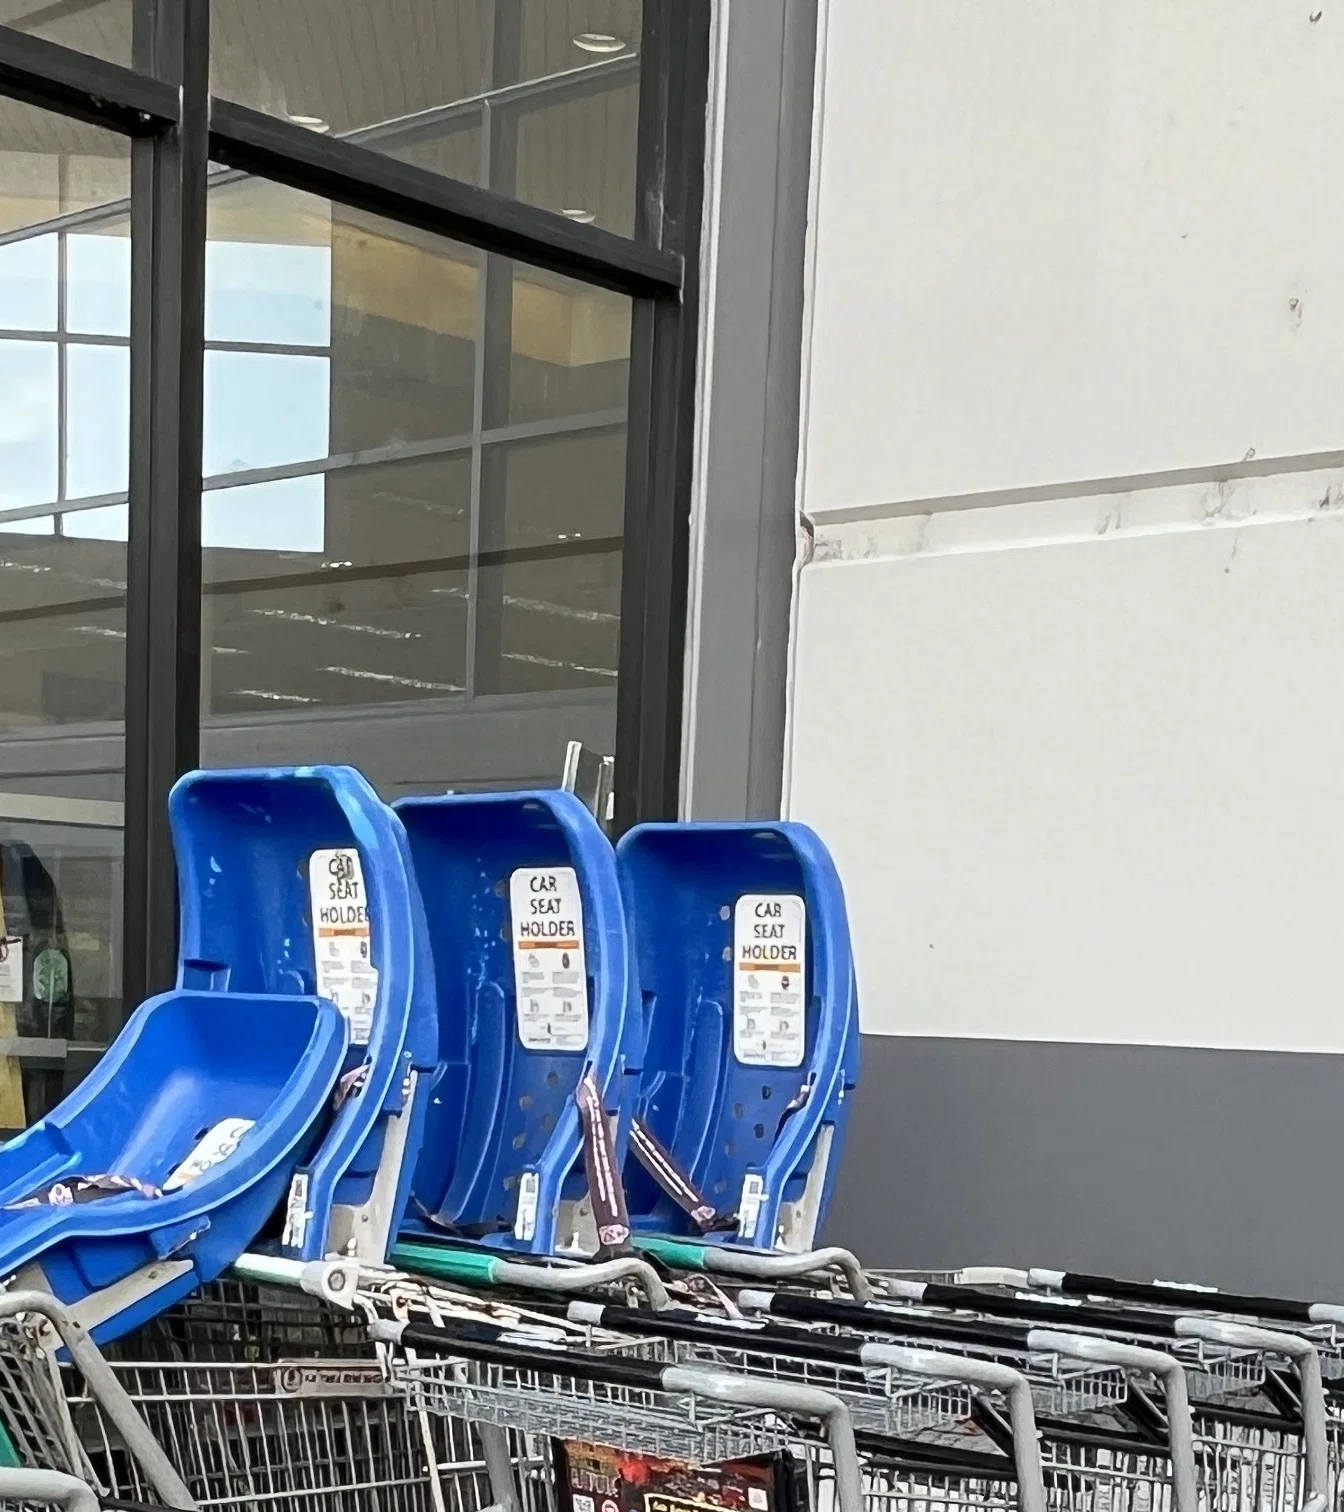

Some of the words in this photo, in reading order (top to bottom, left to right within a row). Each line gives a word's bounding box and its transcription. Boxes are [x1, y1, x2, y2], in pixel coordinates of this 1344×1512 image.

[329, 882, 359, 900] SEAT
[530, 875, 558, 892] CAR
[530, 898, 562, 915] SEAT
[754, 902, 782, 918] CAR
[519, 920, 575, 937] HOLDER
[753, 924, 785, 938] SEAT
[742, 945, 797, 960] HOLDER
